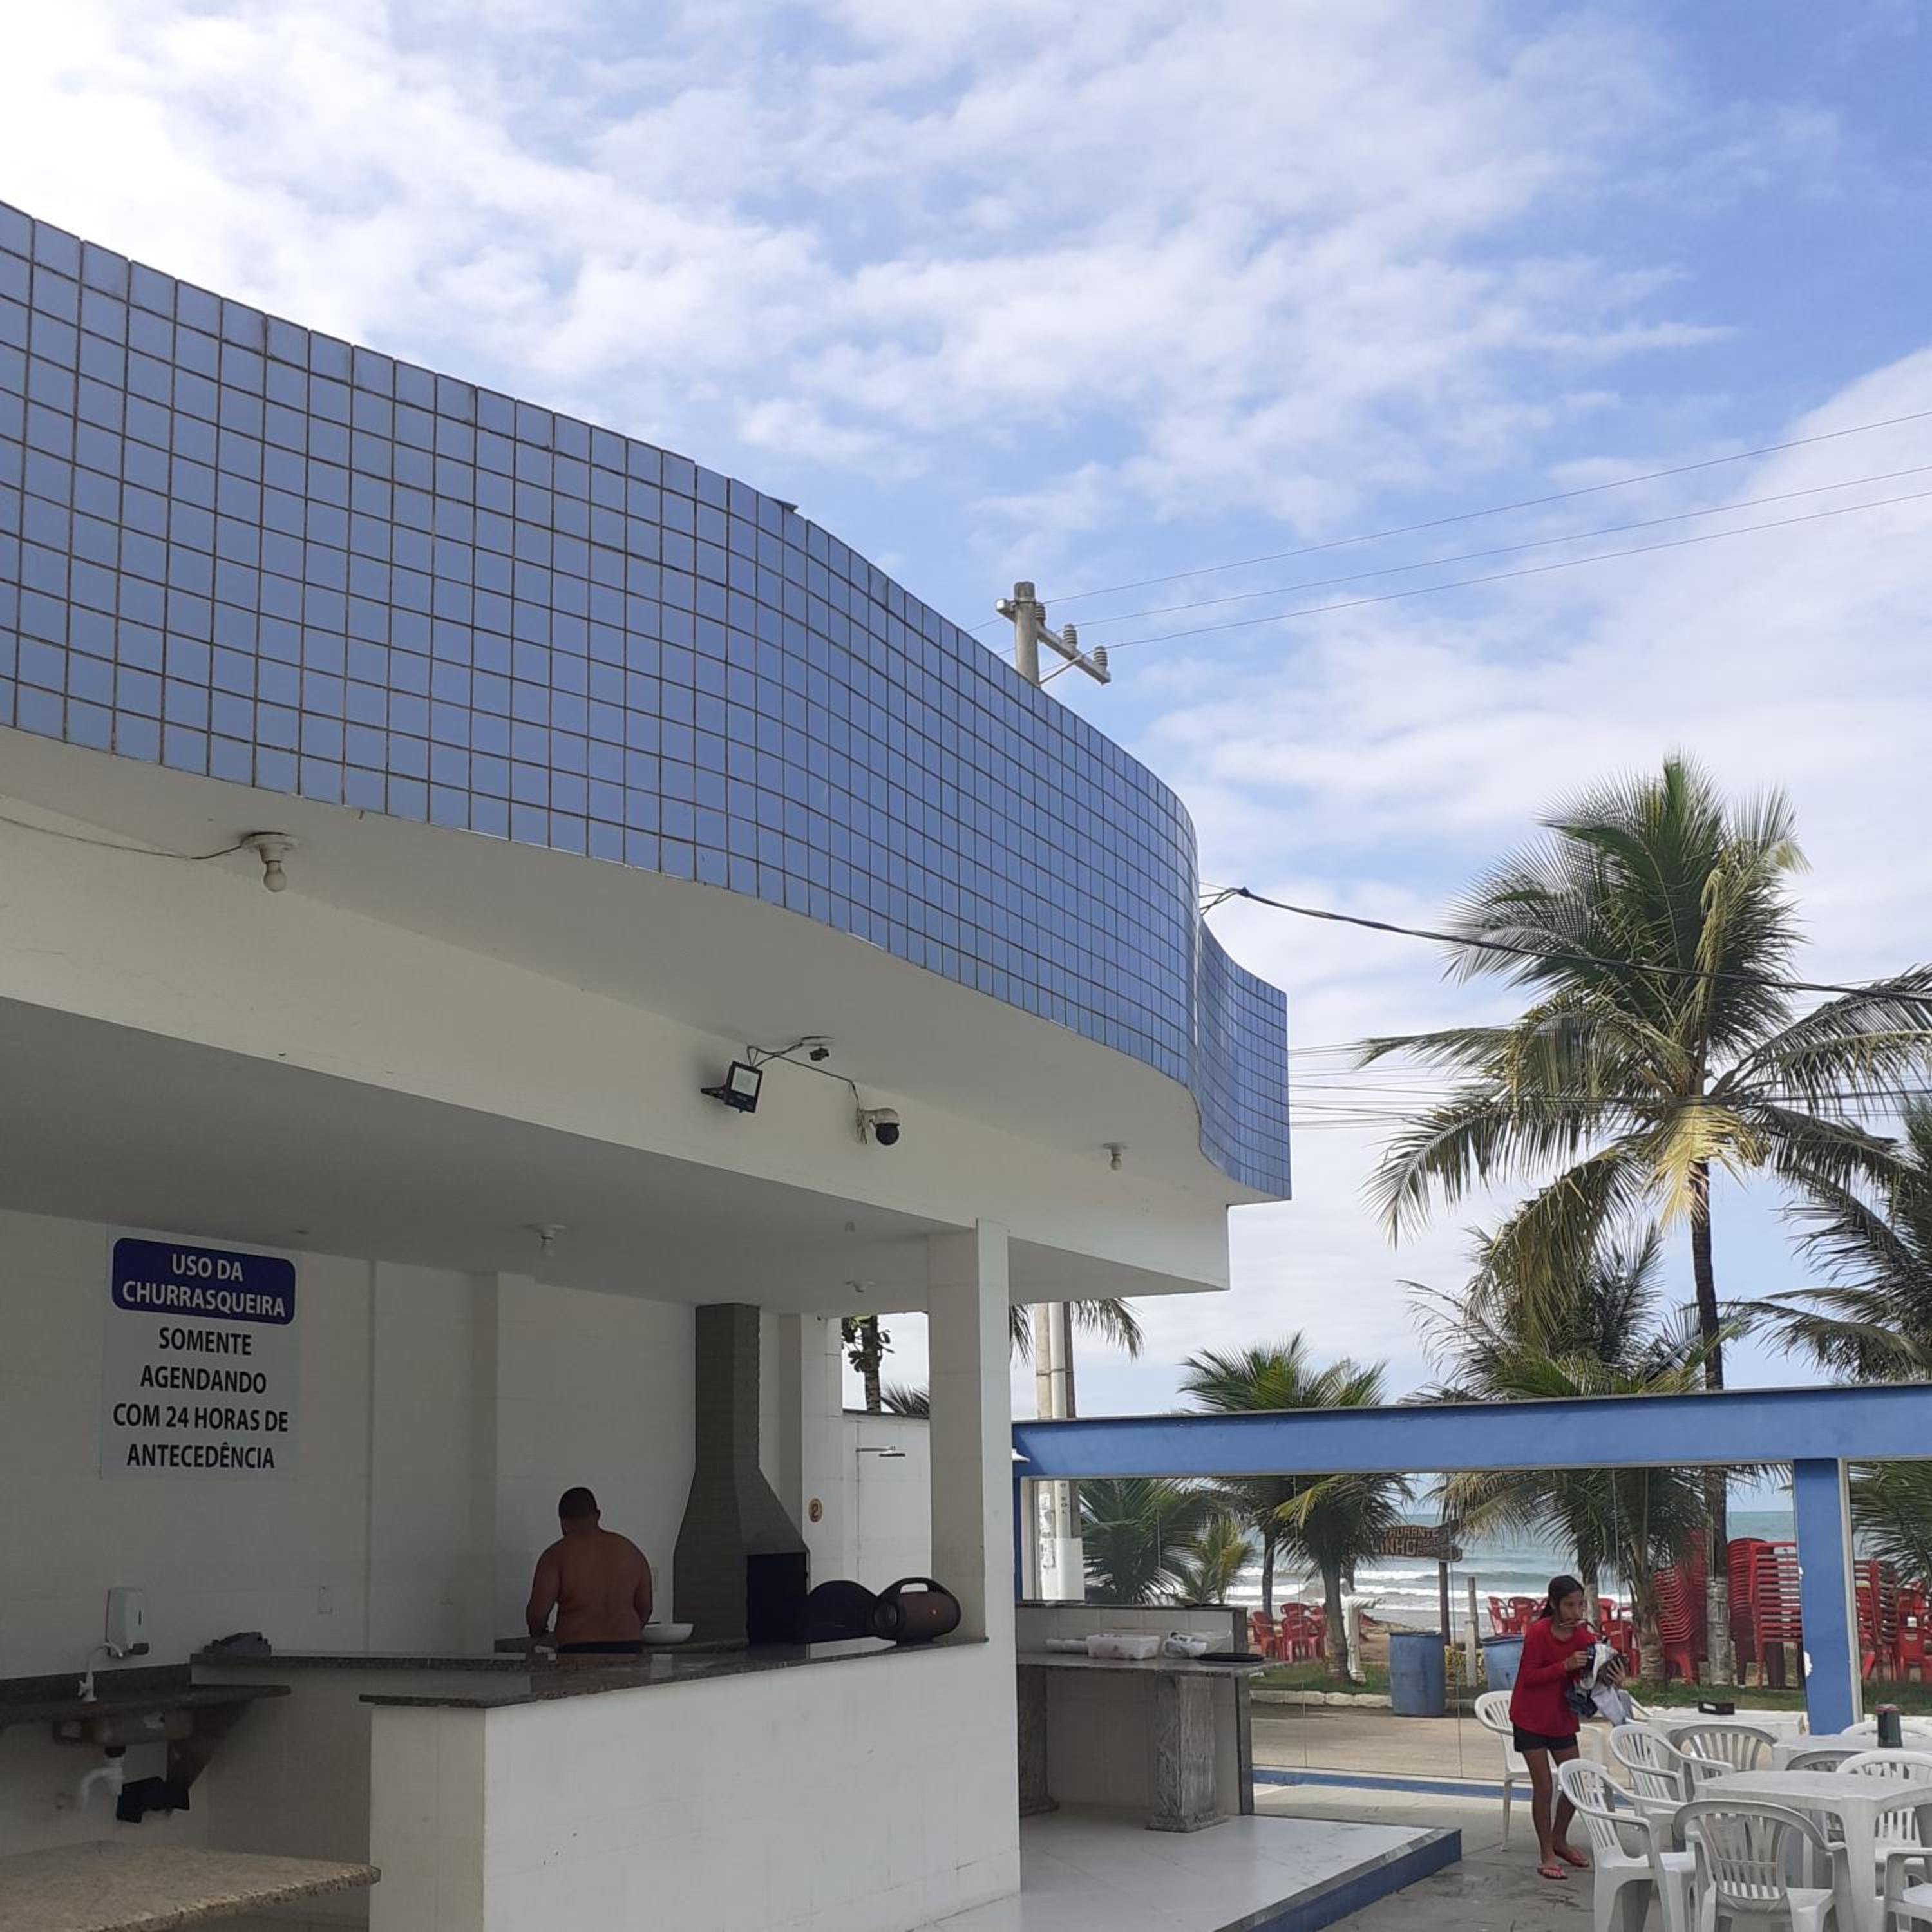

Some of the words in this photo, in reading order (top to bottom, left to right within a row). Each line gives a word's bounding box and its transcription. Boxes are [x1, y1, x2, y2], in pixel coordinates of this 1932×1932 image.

[172, 1253, 212, 1277] USO
[218, 1260, 243, 1282] DA
[122, 1280, 285, 1316] CHURRASQUEIRA
[159, 1327, 252, 1355] SOMENTE
[140, 1365, 266, 1394] AGENDANDO
[113, 1403, 160, 1427] COM
[166, 1406, 189, 1428] 24
[195, 1407, 260, 1431] HORAS
[265, 1410, 288, 1432] DE
[127, 1442, 275, 1469] ANTECEDÊNCIA
